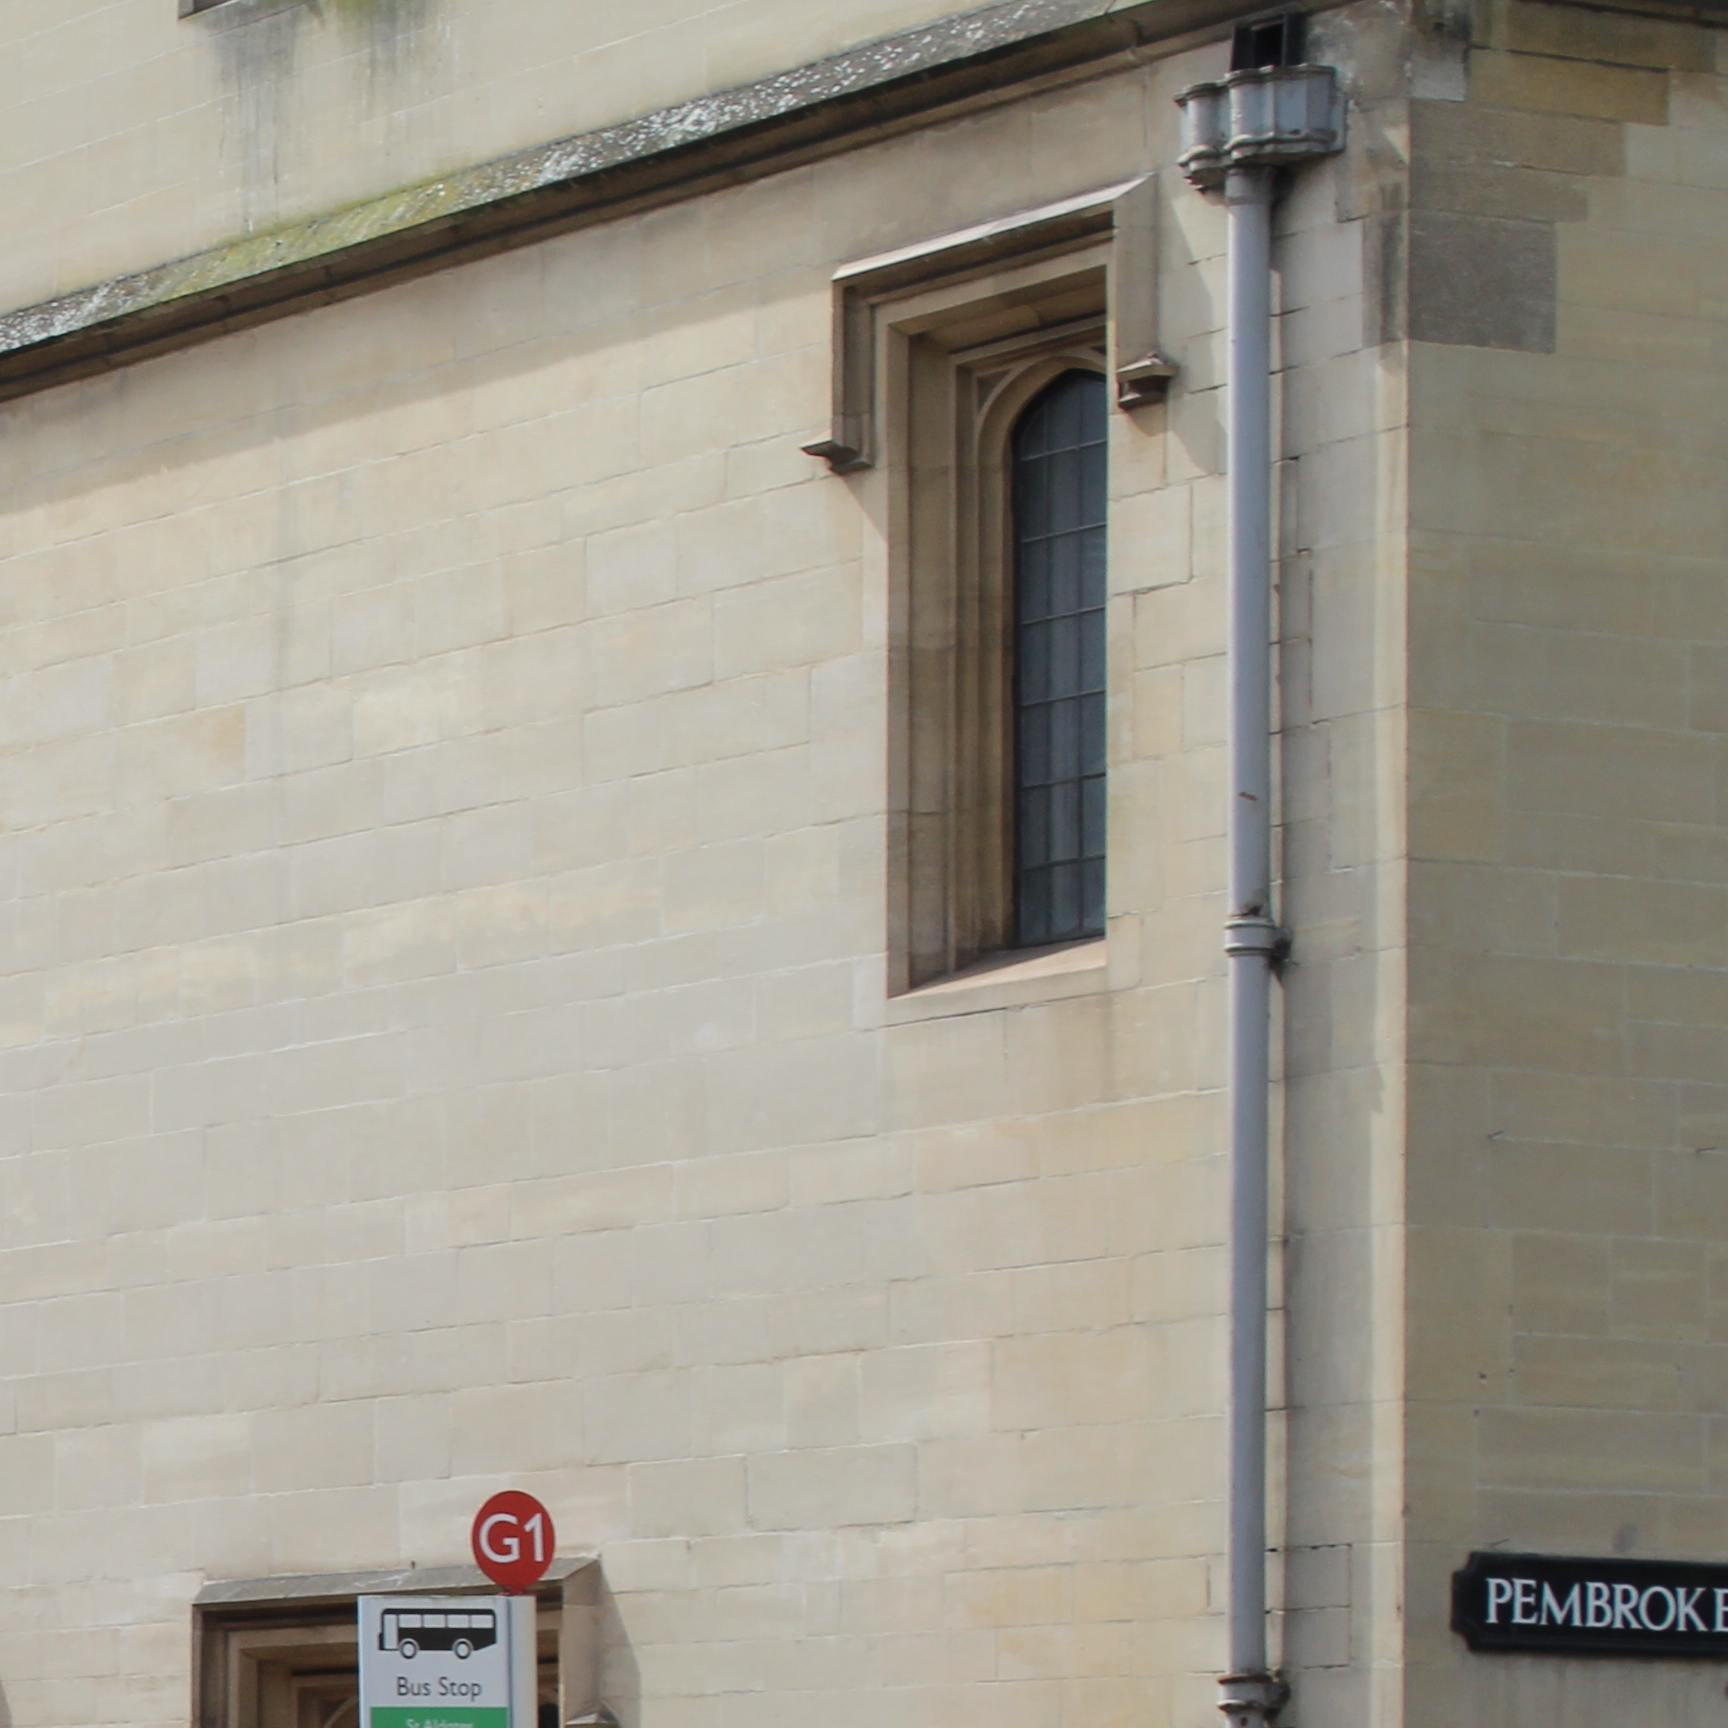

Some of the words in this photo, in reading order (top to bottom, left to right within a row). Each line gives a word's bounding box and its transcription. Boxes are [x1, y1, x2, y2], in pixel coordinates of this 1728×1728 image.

[478, 1512, 545, 1564] G1
[1485, 1577, 1728, 1632] PEMBROKE
[396, 1676, 431, 1697] Bus
[438, 1676, 483, 1701] Stop
